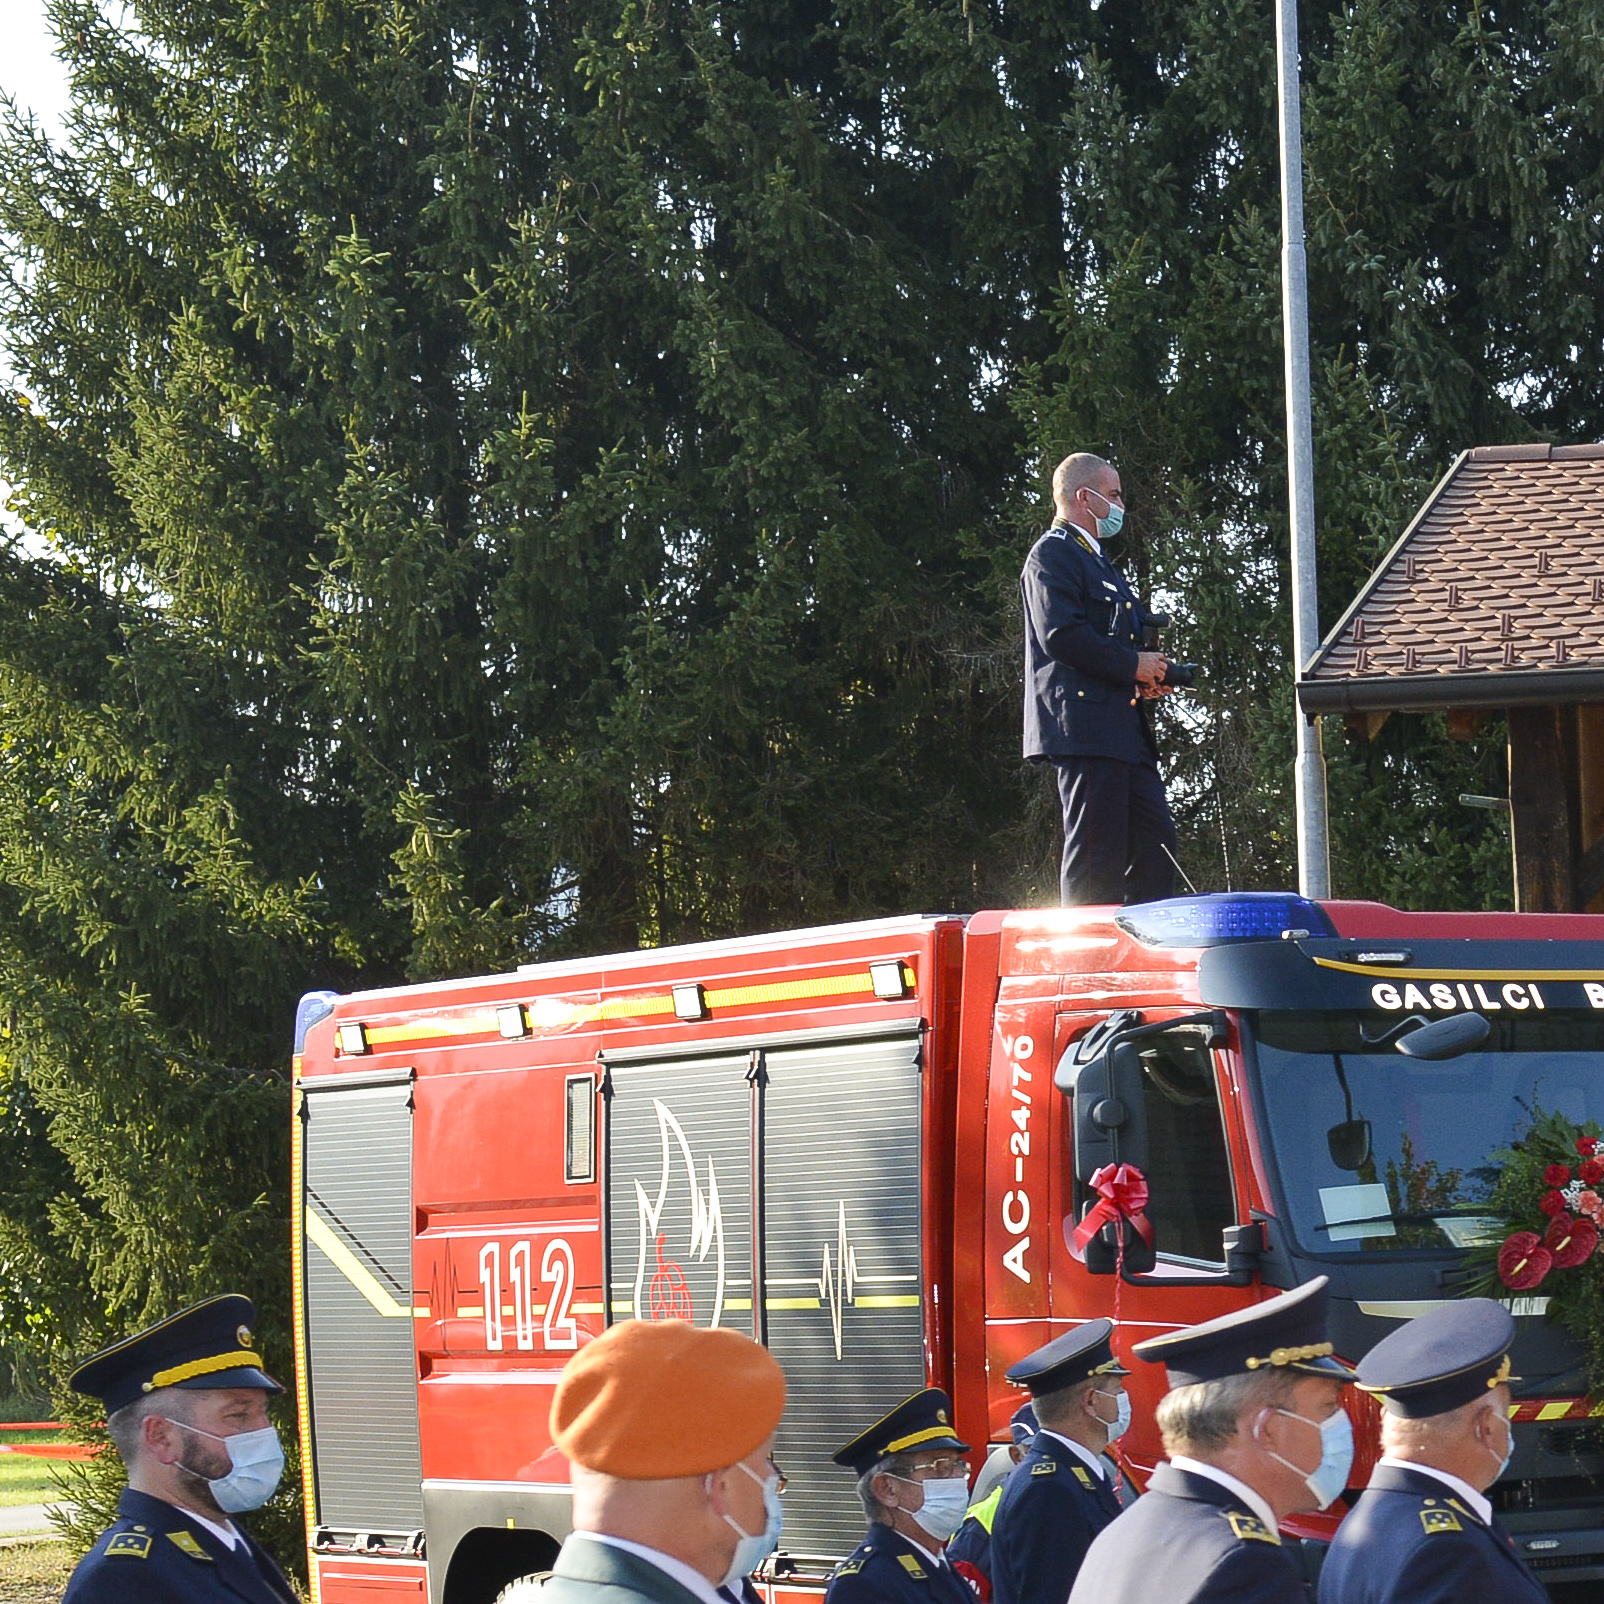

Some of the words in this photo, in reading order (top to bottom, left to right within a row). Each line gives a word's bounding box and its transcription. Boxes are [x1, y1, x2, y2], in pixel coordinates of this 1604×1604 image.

[1371, 983, 1544, 1010] GASILCI
[1002, 1034, 1035, 1284] AC-24/70
[479, 1238, 578, 1351] 112
